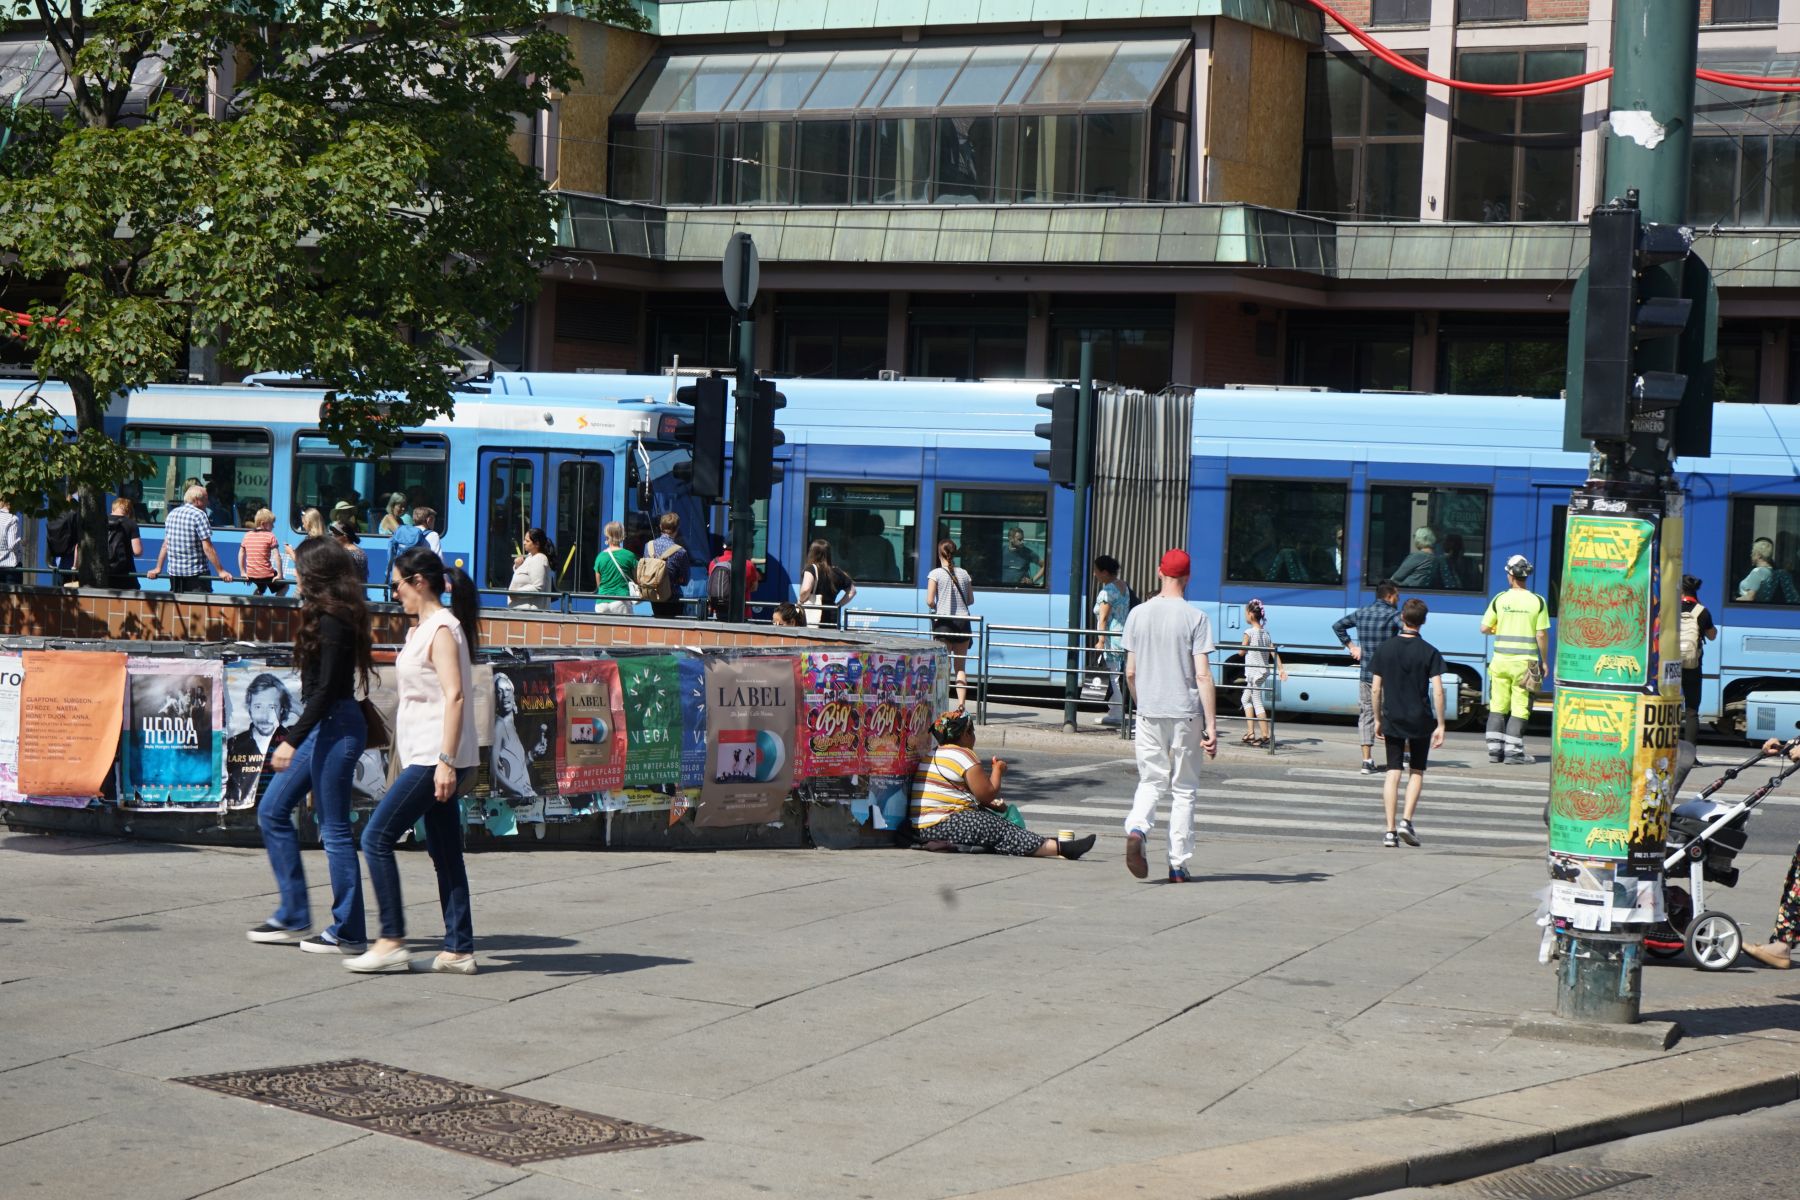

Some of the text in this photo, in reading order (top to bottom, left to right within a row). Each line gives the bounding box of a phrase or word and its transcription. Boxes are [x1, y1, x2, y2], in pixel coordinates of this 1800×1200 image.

[571, 696, 607, 707] LABEL
[718, 686, 787, 707] LABEL
[816, 703, 852, 736] Big
[870, 703, 898, 736] Big
[143, 716, 199, 744] HEDDA
[631, 729, 670, 744] VEGA
[228, 754, 247, 763] LARS
[625, 763, 640, 771] SLOS
